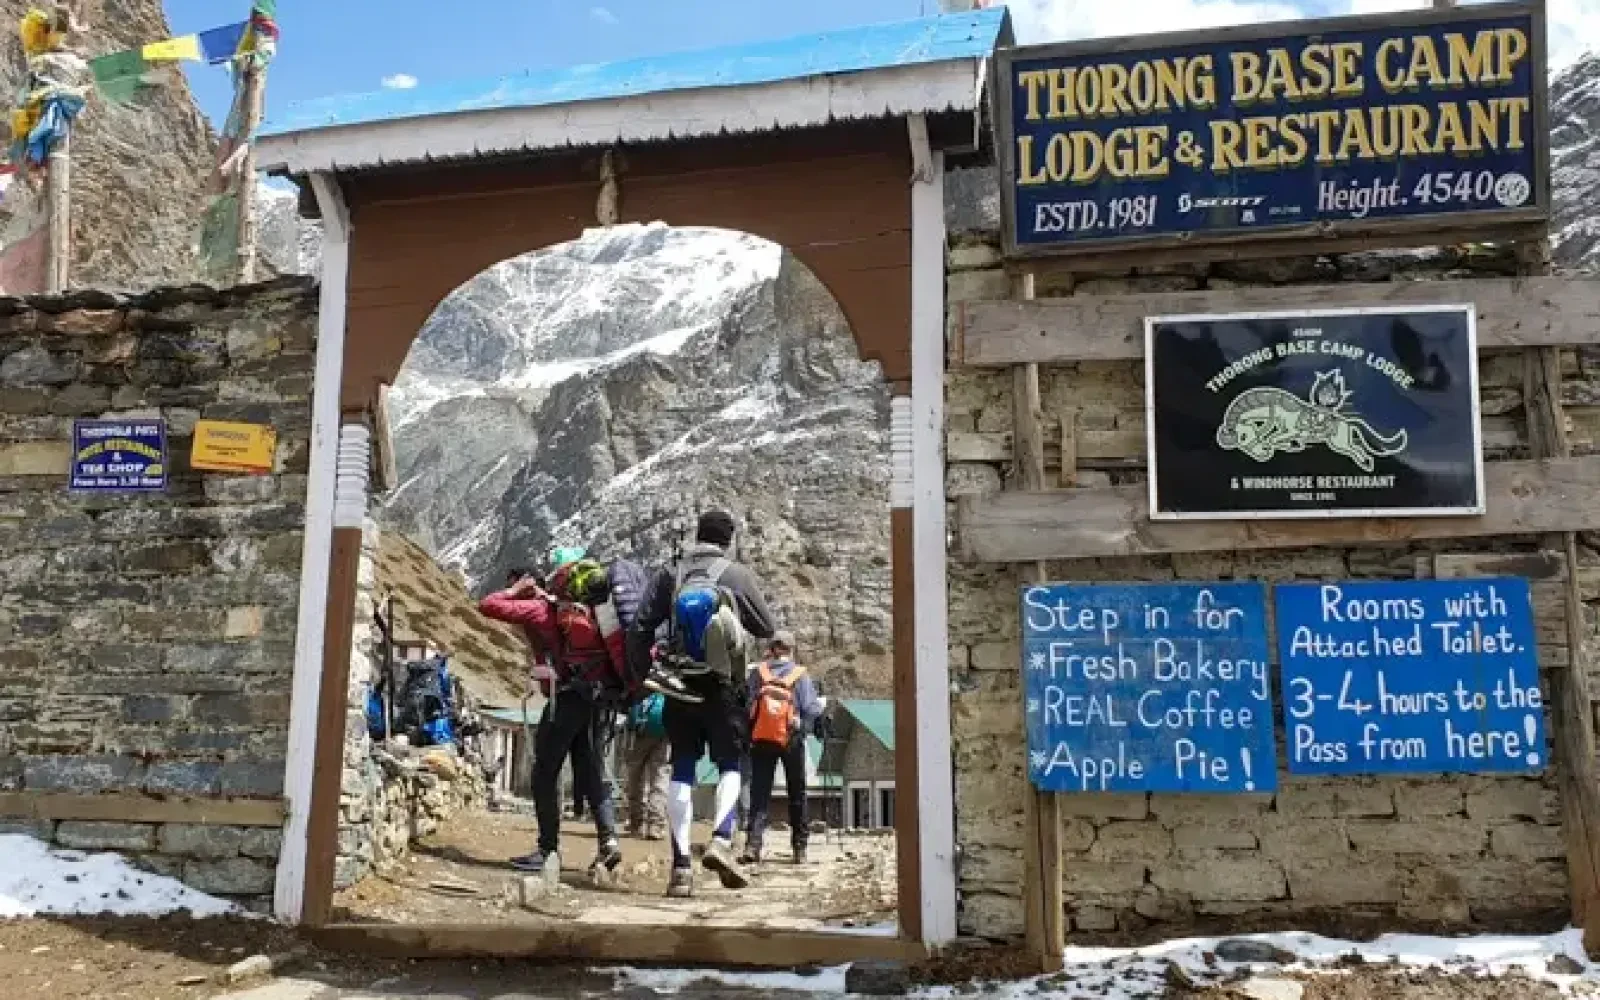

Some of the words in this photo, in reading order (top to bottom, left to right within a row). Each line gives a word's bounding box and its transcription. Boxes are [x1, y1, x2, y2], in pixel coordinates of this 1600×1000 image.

[1018, 54, 1216, 121] THORONG
[1229, 41, 1365, 103] BASE
[1375, 27, 1528, 93] CAMP
[1016, 125, 1170, 186] LODGE
[1174, 130, 1204, 168] &
[1208, 97, 1530, 174] RESTAURANT
[1317, 176, 1408, 218] Height.
[1412, 169, 1494, 204] 4540
[1204, 347, 1274, 394] THORONG
[1275, 339, 1316, 358] BASE
[1320, 340, 1365, 361] CAMP
[1366, 352, 1415, 390] LODGE
[1242, 476, 1314, 489] WINDHORSE
[1316, 475, 1396, 489] RESTAURANT
[1025, 586, 1120, 646] Step
[1144, 603, 1170, 630] in
[1192, 589, 1245, 630] for
[1320, 585, 1426, 623] Rooms
[1444, 585, 1508, 619] with
[1289, 623, 1423, 658] Attached
[1430, 620, 1525, 655] Toilet.
[1154, 637, 1268, 701] Bakery
[1288, 670, 1373, 719] 3-4
[1377, 670, 1449, 716] hours
[1454, 678, 1487, 712] to
[1492, 666, 1543, 710] the
[1136, 689, 1254, 729] Coffee
[1294, 723, 1349, 763] Pass
[1356, 720, 1427, 761] from
